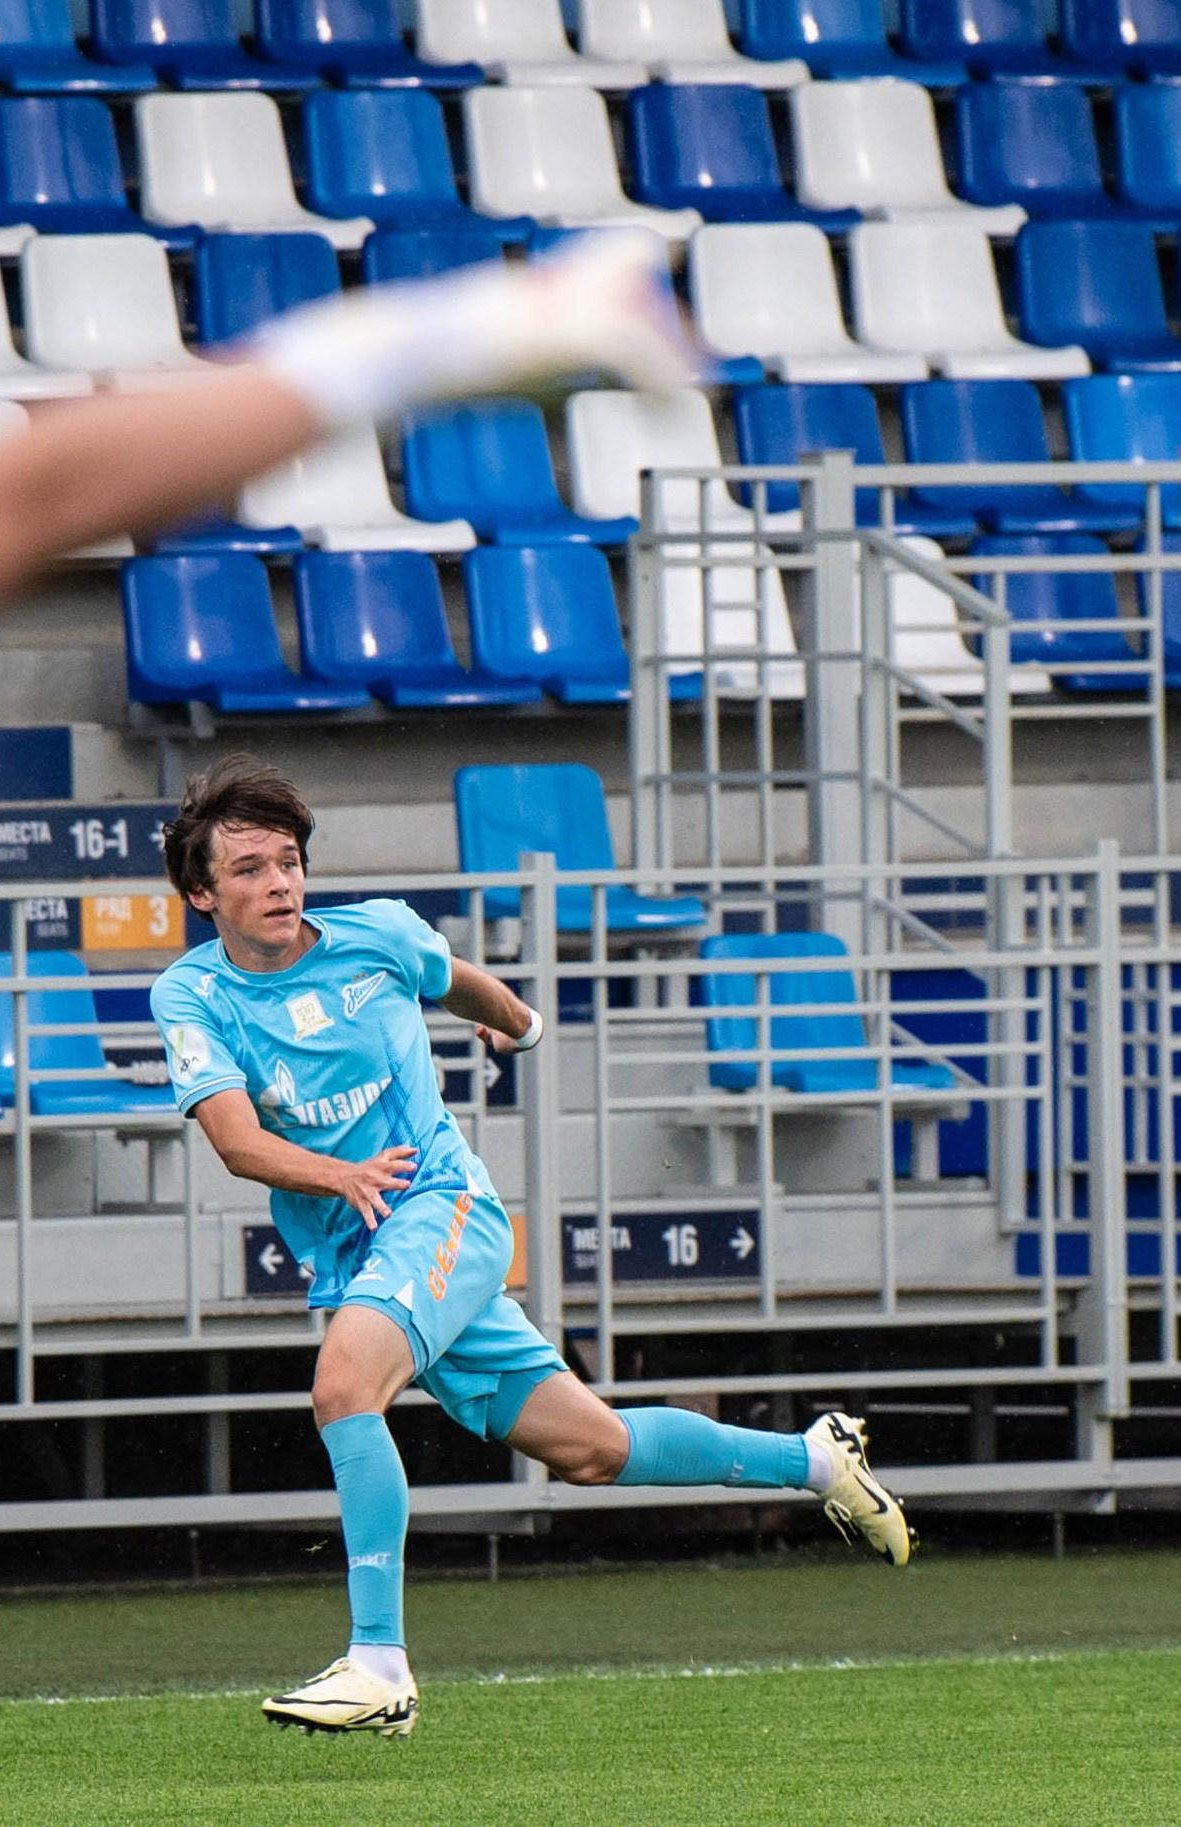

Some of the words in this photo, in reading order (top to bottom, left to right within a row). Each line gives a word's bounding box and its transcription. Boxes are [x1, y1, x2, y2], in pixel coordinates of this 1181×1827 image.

[71, 818, 128, 860] 16-1
[25, 899, 68, 921] ЕСТА
[149, 897, 169, 937] 3
[573, 1225, 631, 1251] МЕТА
[662, 1223, 698, 1267] 16
